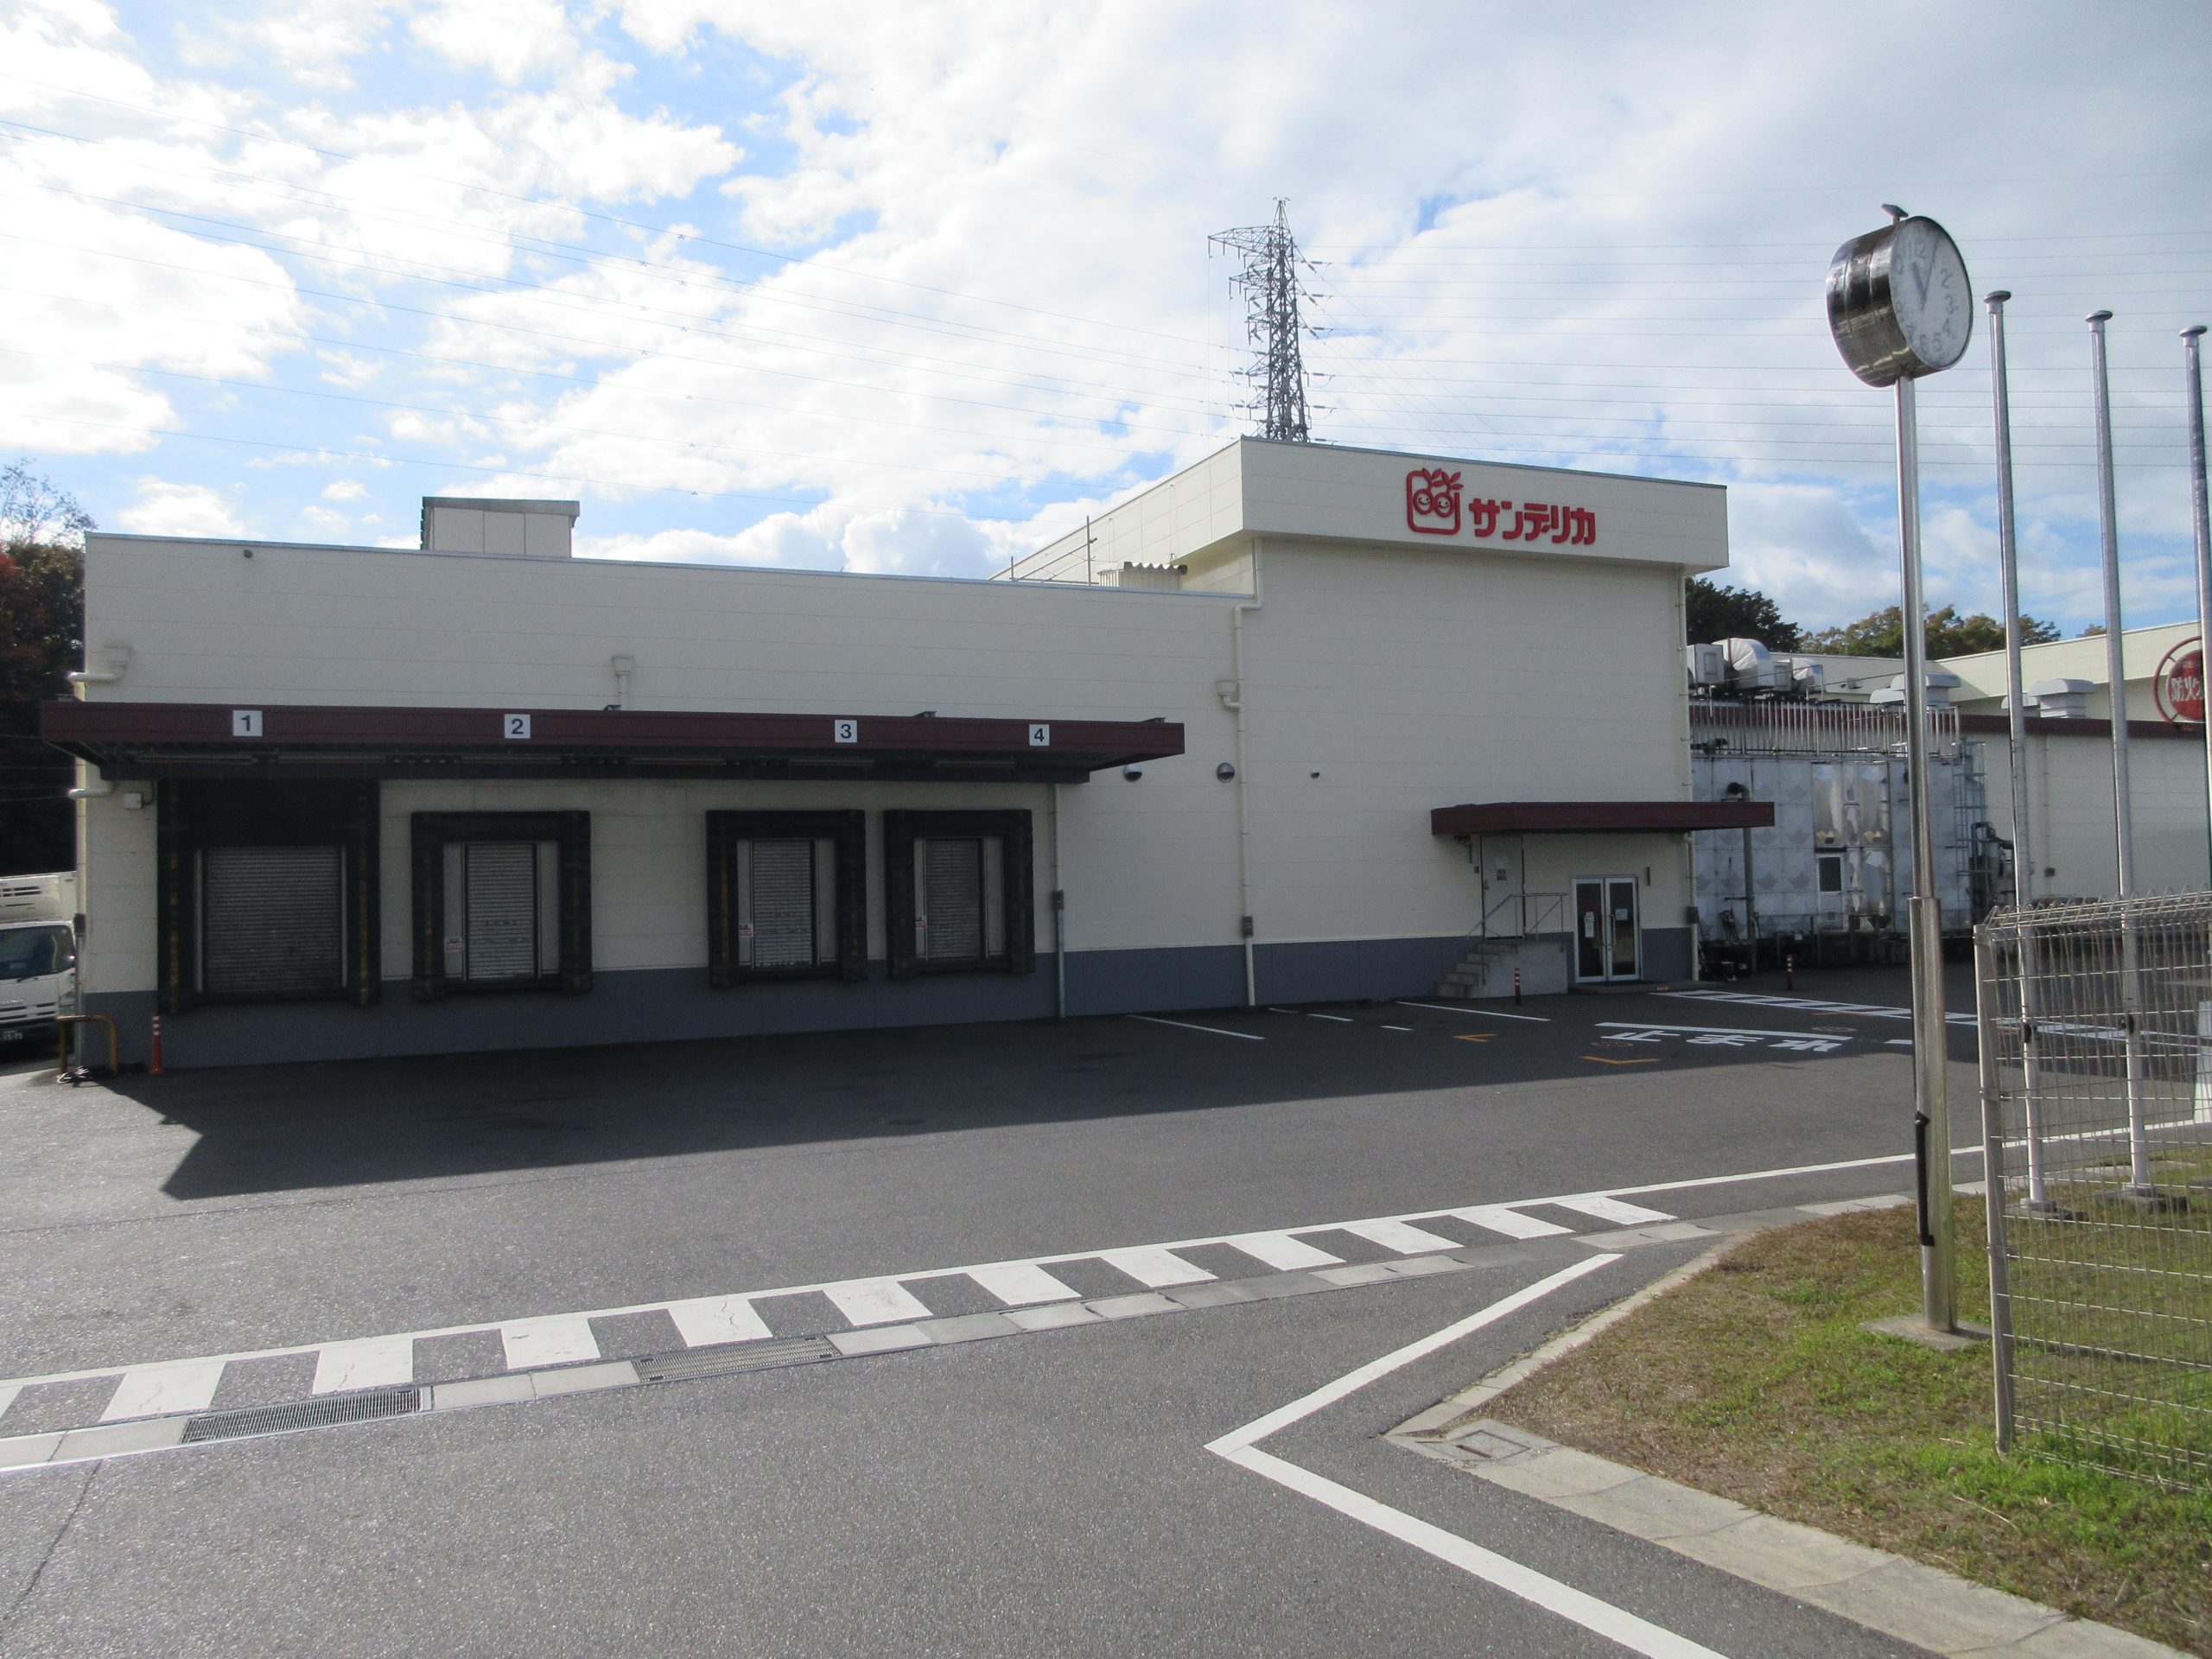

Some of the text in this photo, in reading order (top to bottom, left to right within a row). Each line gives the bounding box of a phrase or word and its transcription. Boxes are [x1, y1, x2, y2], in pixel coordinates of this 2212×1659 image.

[1469, 498, 1596, 544] サンデリカ
[241, 715, 251, 732] 1
[511, 718, 524, 735] 2
[840, 723, 852, 740] 3
[1033, 728, 1046, 743] 4
[1600, 1029, 1843, 1052] 止まれ
